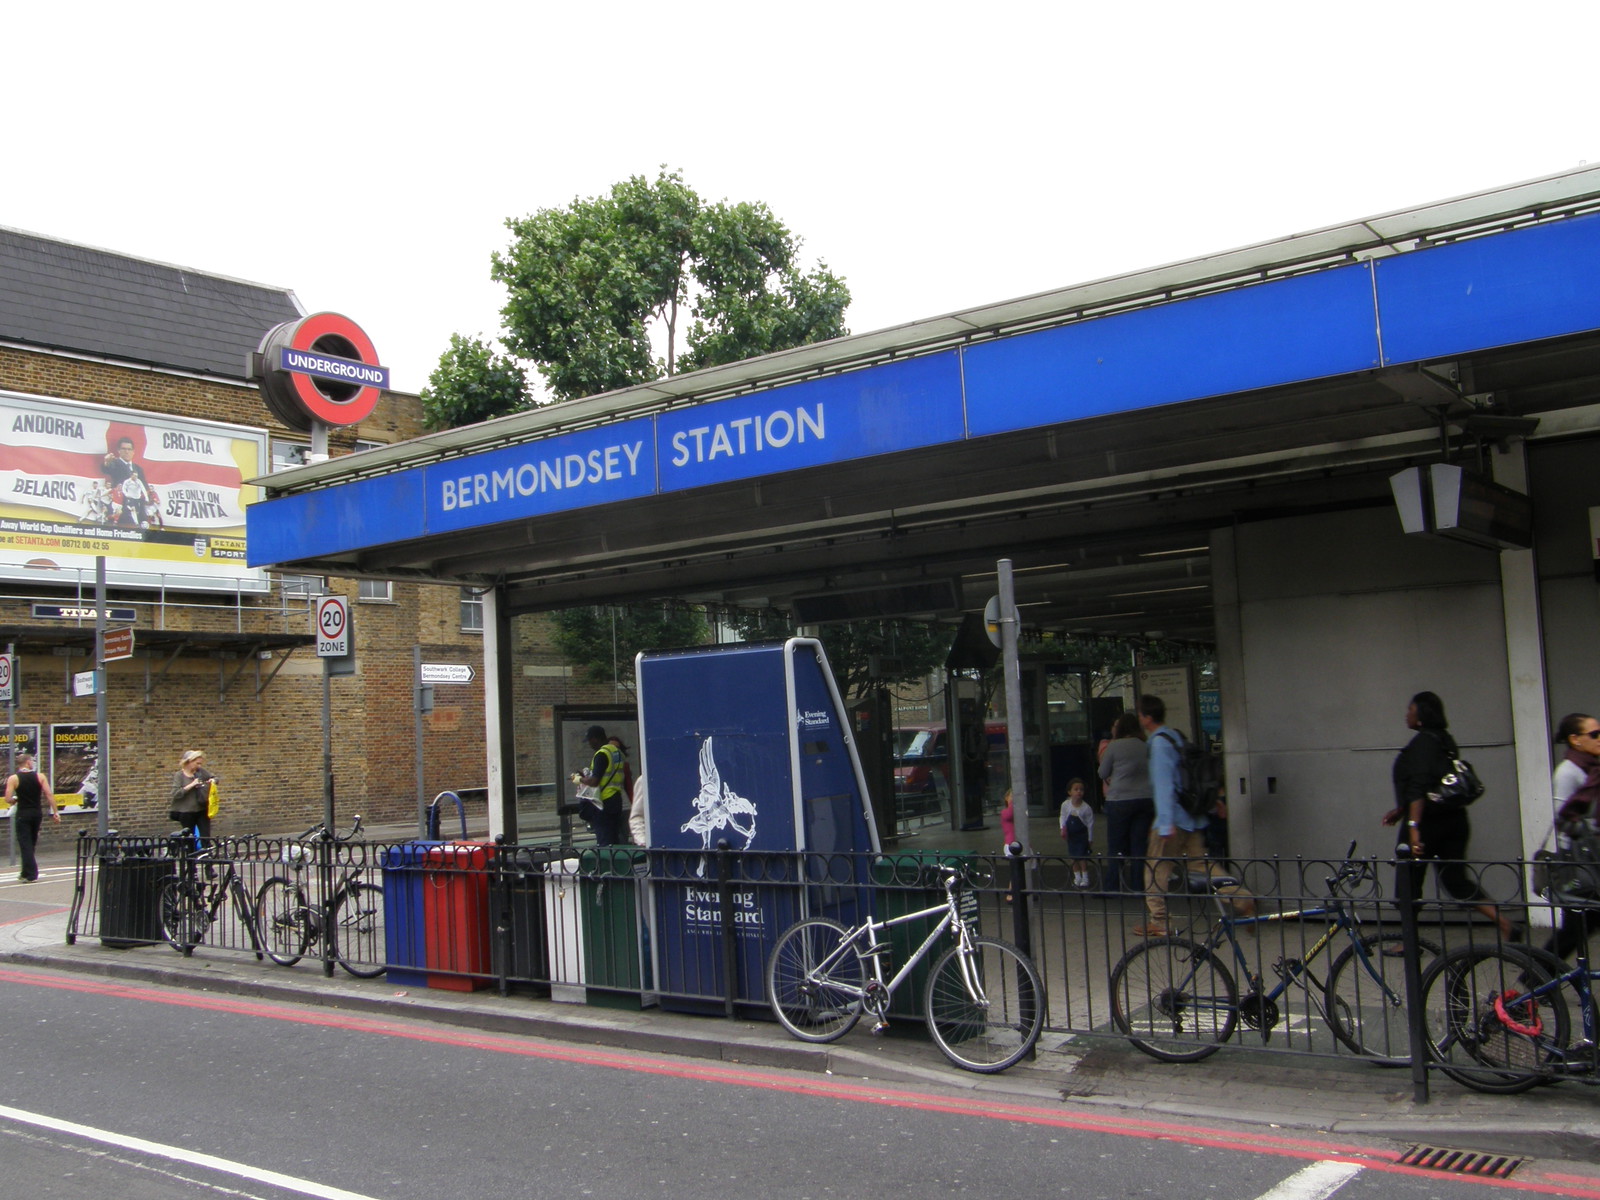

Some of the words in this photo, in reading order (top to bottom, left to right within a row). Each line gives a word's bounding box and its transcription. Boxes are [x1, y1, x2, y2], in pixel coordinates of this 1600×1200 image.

[287, 352, 384, 384] UNDERGROUND
[12, 414, 85, 440] ANDORRA
[162, 431, 214, 456] CROATIA
[442, 440, 644, 511] BERMONDSEY
[672, 402, 826, 467] STATION
[12, 477, 77, 502] BELARUS
[167, 489, 186, 500] LIVE
[186, 490, 206, 502] ONLY
[207, 492, 220, 503] ON
[166, 499, 228, 519] SETANTA
[0, 520, 19, 531] Away
[19, 521, 40, 532] World
[40, 523, 53, 534] Cup
[53, 524, 84, 536] Qualifiers
[84, 526, 96, 536] and
[96, 528, 113, 537] Home
[113, 529, 143, 540] Friendlies
[15, 536, 61, 547] SETANTA.COM
[61, 539, 81, 549] 08712
[82, 540, 91, 549] 00
[92, 541, 100, 550] 42
[101, 542, 110, 551] 55
[214, 540, 246, 548] SETANT
[214, 550, 245, 558] SPORT
[322, 610, 343, 627] 20
[319, 641, 346, 653] ZONE
[804, 710, 827, 718] Evening
[804, 716, 830, 726] Standard
[685, 886, 754, 908] Evenng
[685, 904, 765, 924] Stanard
